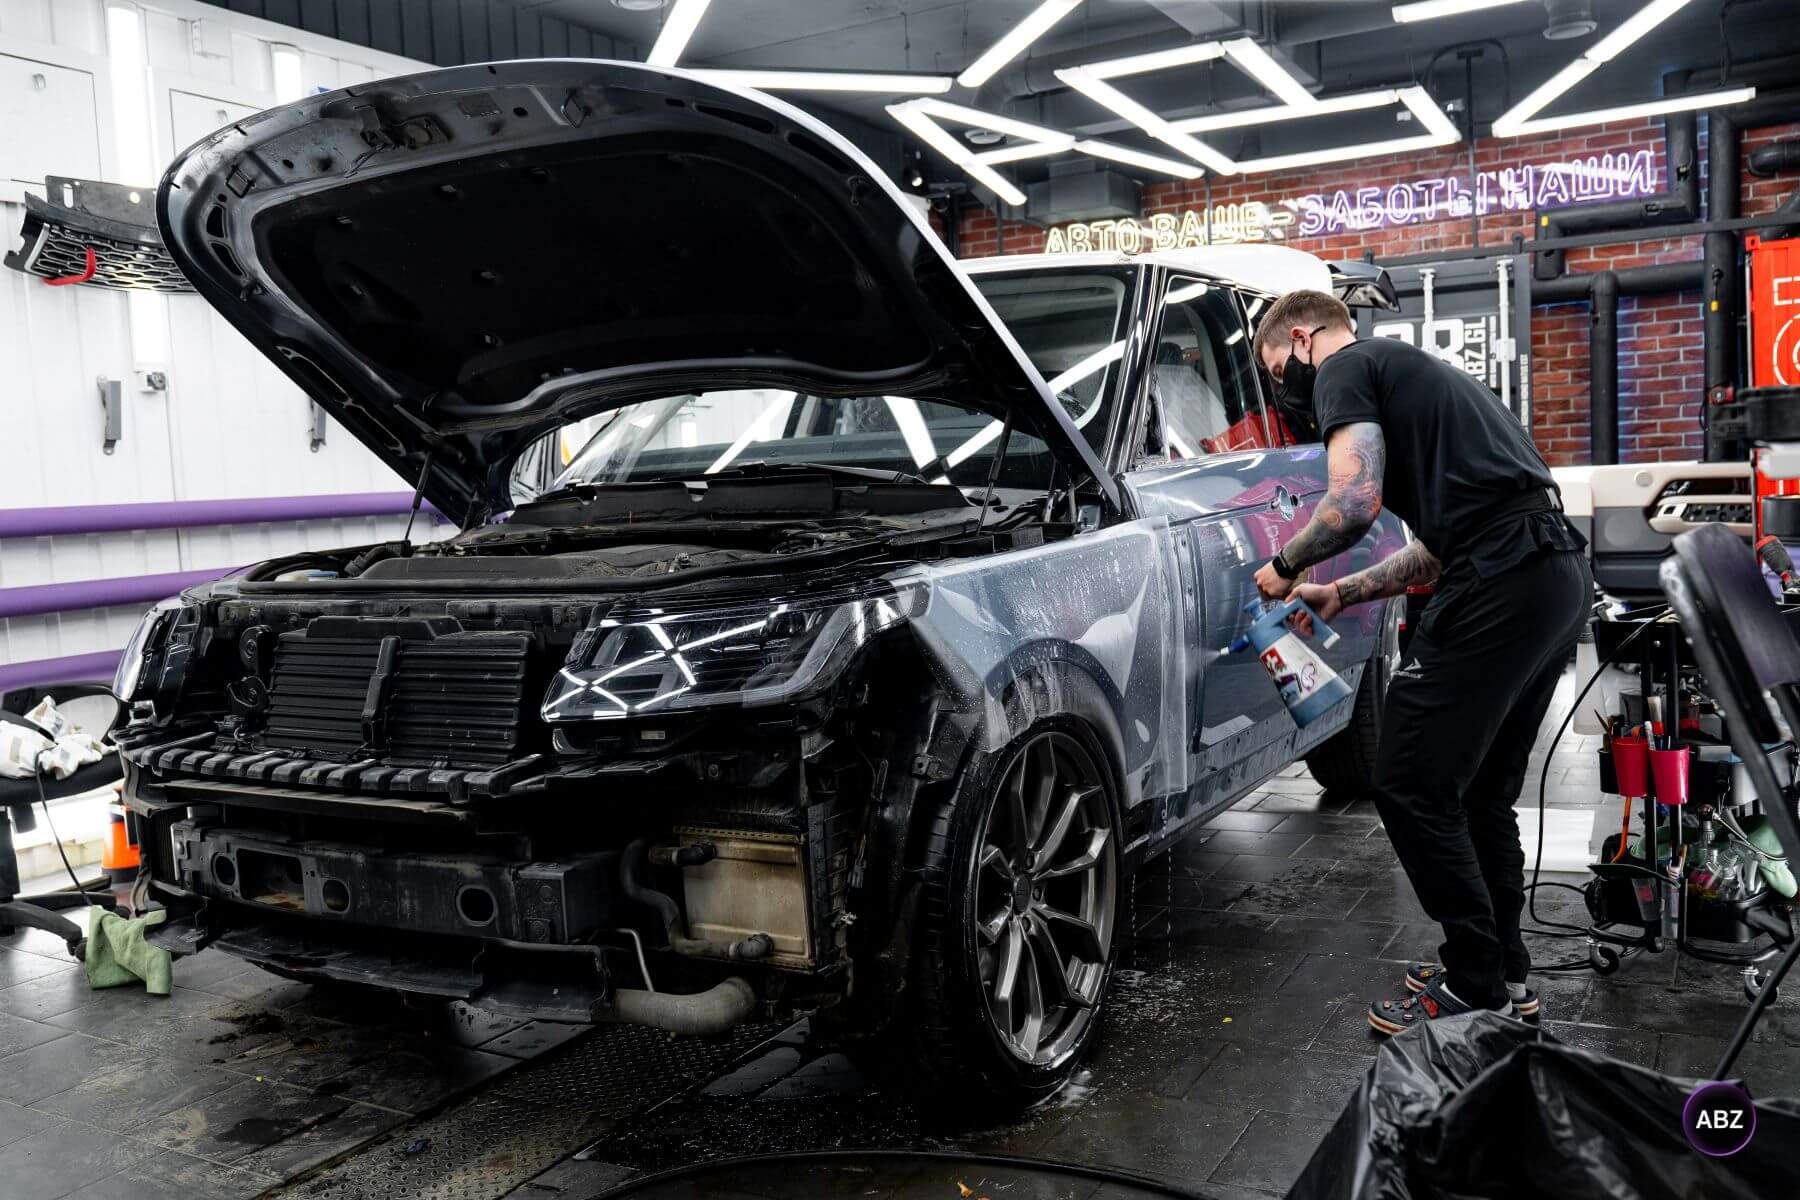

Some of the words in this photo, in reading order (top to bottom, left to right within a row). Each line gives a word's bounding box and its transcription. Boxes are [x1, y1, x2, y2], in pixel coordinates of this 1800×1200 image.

[1046, 217, 1142, 255] АВТО
[1151, 201, 1267, 251] ВАШЕ
[1299, 172, 1488, 236] ЗАБОТЫ
[1501, 150, 1656, 210] НАШИ
